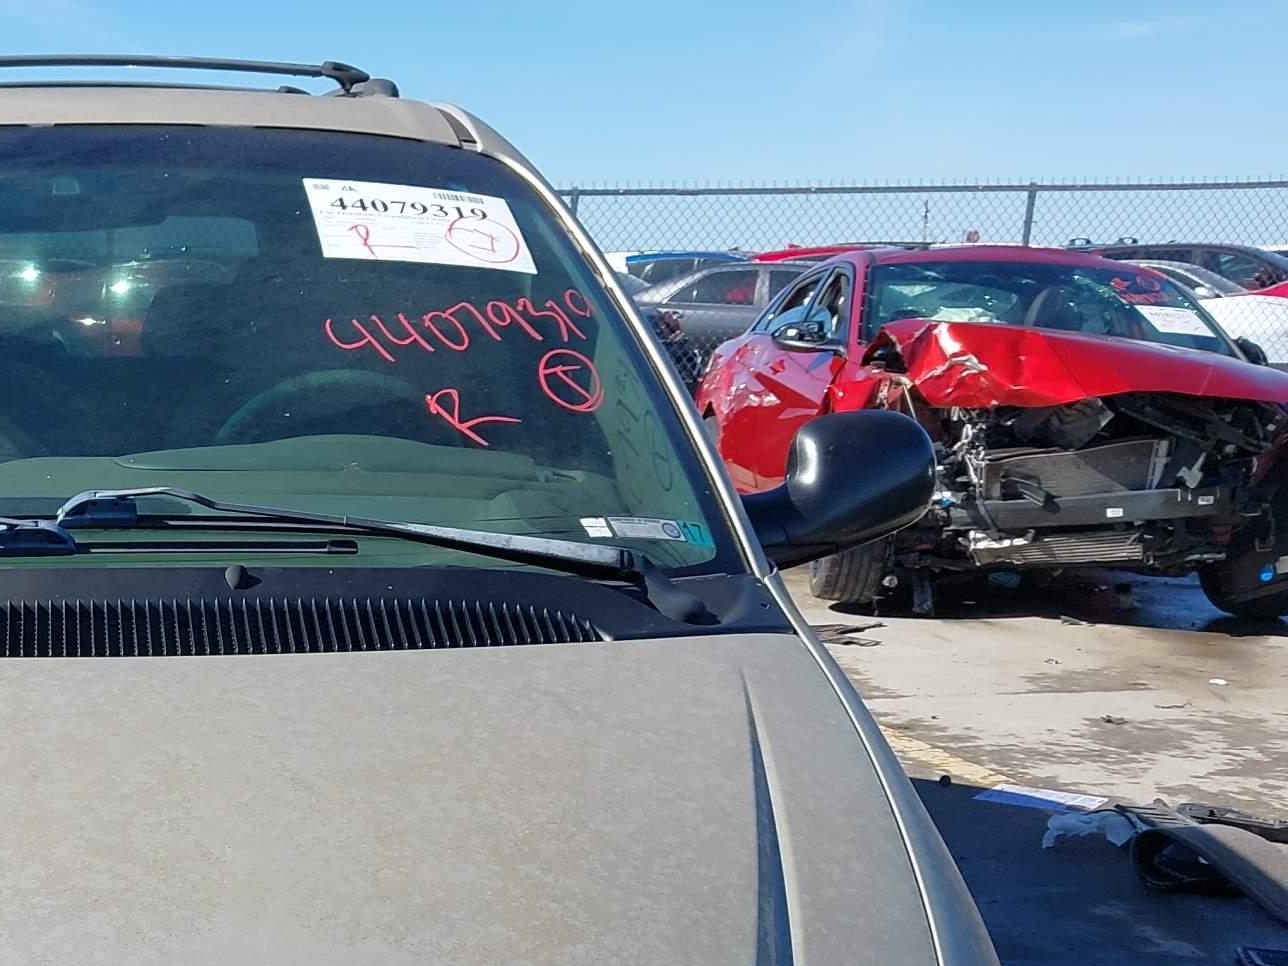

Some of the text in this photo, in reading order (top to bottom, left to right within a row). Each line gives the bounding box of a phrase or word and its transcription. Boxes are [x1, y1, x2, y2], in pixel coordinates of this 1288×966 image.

[330, 196, 488, 221] 44079319
[424, 387, 522, 447] R
[681, 521, 706, 543] 17
